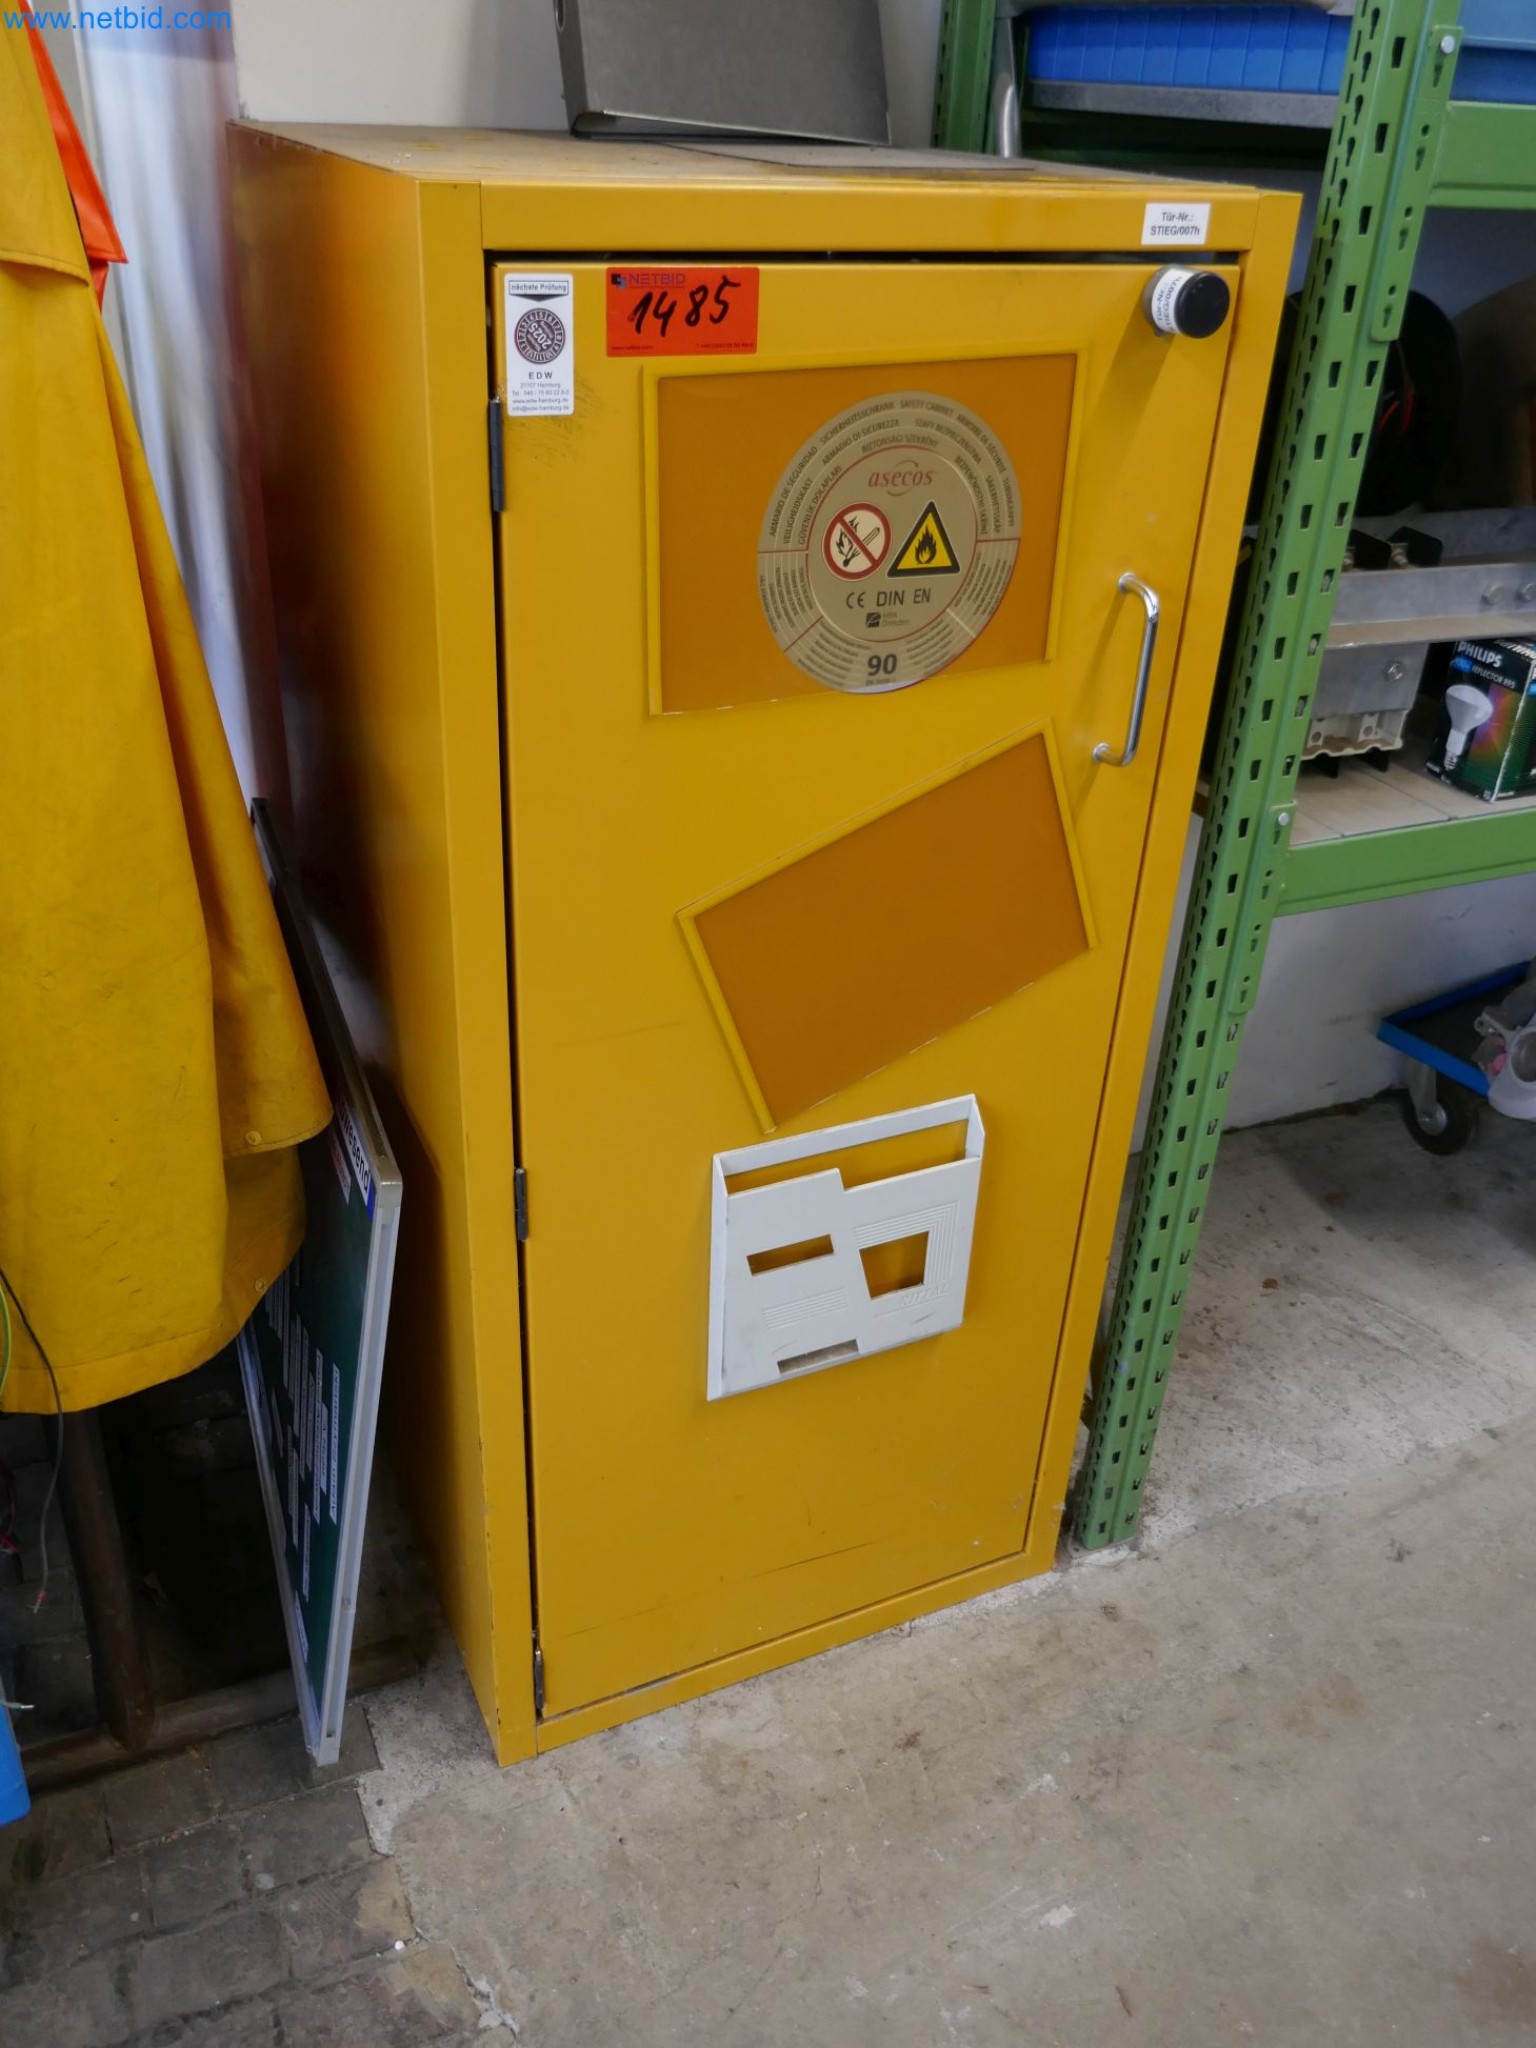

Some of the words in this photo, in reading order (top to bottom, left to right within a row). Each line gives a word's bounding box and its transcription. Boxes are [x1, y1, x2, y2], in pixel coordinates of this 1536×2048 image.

[1161, 212, 1193, 221] Tür-Nr.:
[1150, 226, 1200, 236] STIEG/007h
[540, 284, 566, 292] Prüfung
[629, 274, 686, 284] NETBID
[627, 275, 741, 337] 1485
[529, 323, 551, 349] 2025
[768, 498, 786, 536] ARMARIO
[779, 486, 791, 499] DE
[785, 444, 818, 488] SEGURIDAD
[818, 400, 893, 445] SICHERHEITSSCHRANK
[869, 468, 934, 489] asecos
[782, 476, 813, 544] VEILIGHEIDSKAST
[819, 434, 852, 466] ARMADIO
[877, 590, 904, 606] DIN
[914, 588, 931, 604] EN
[1457, 641, 1502, 667] PHILIPS
[867, 654, 898, 676] 90
